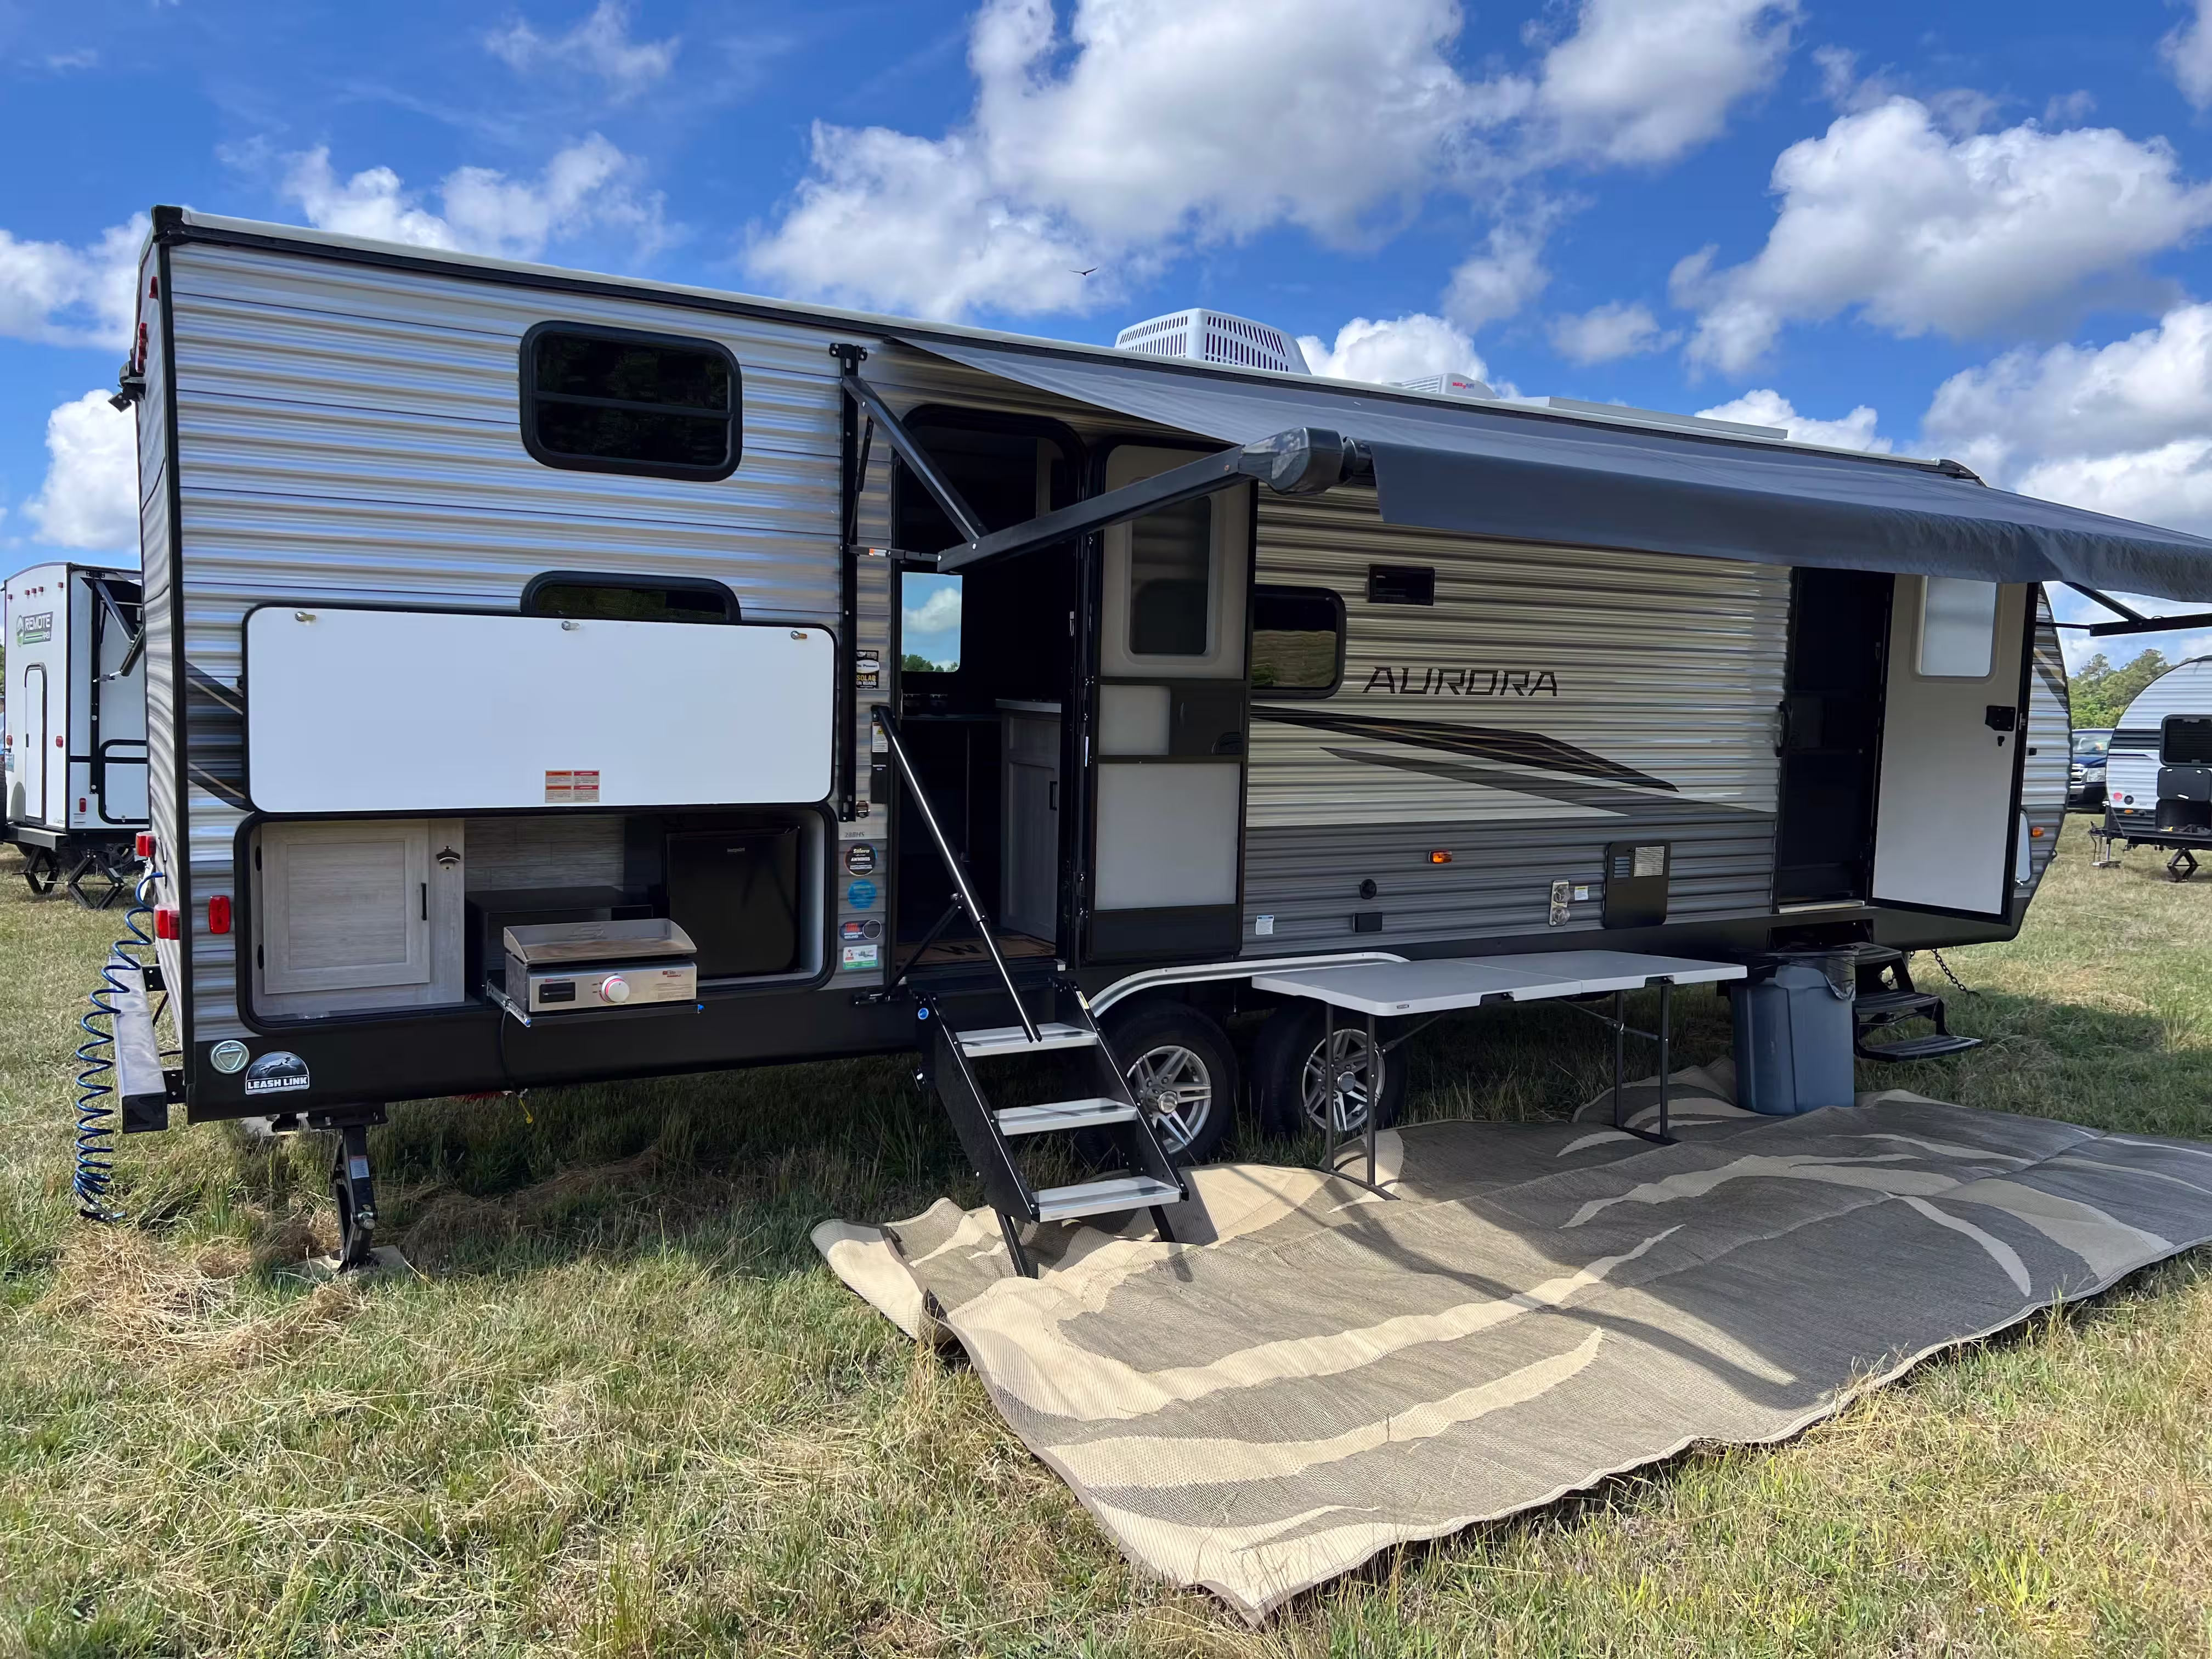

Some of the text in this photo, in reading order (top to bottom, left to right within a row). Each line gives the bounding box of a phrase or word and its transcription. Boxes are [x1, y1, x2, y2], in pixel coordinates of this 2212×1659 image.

[25, 614, 50, 631] REMOTE
[1362, 667, 1558, 697] AURORA
[247, 1076, 308, 1090] LEASH LINK
